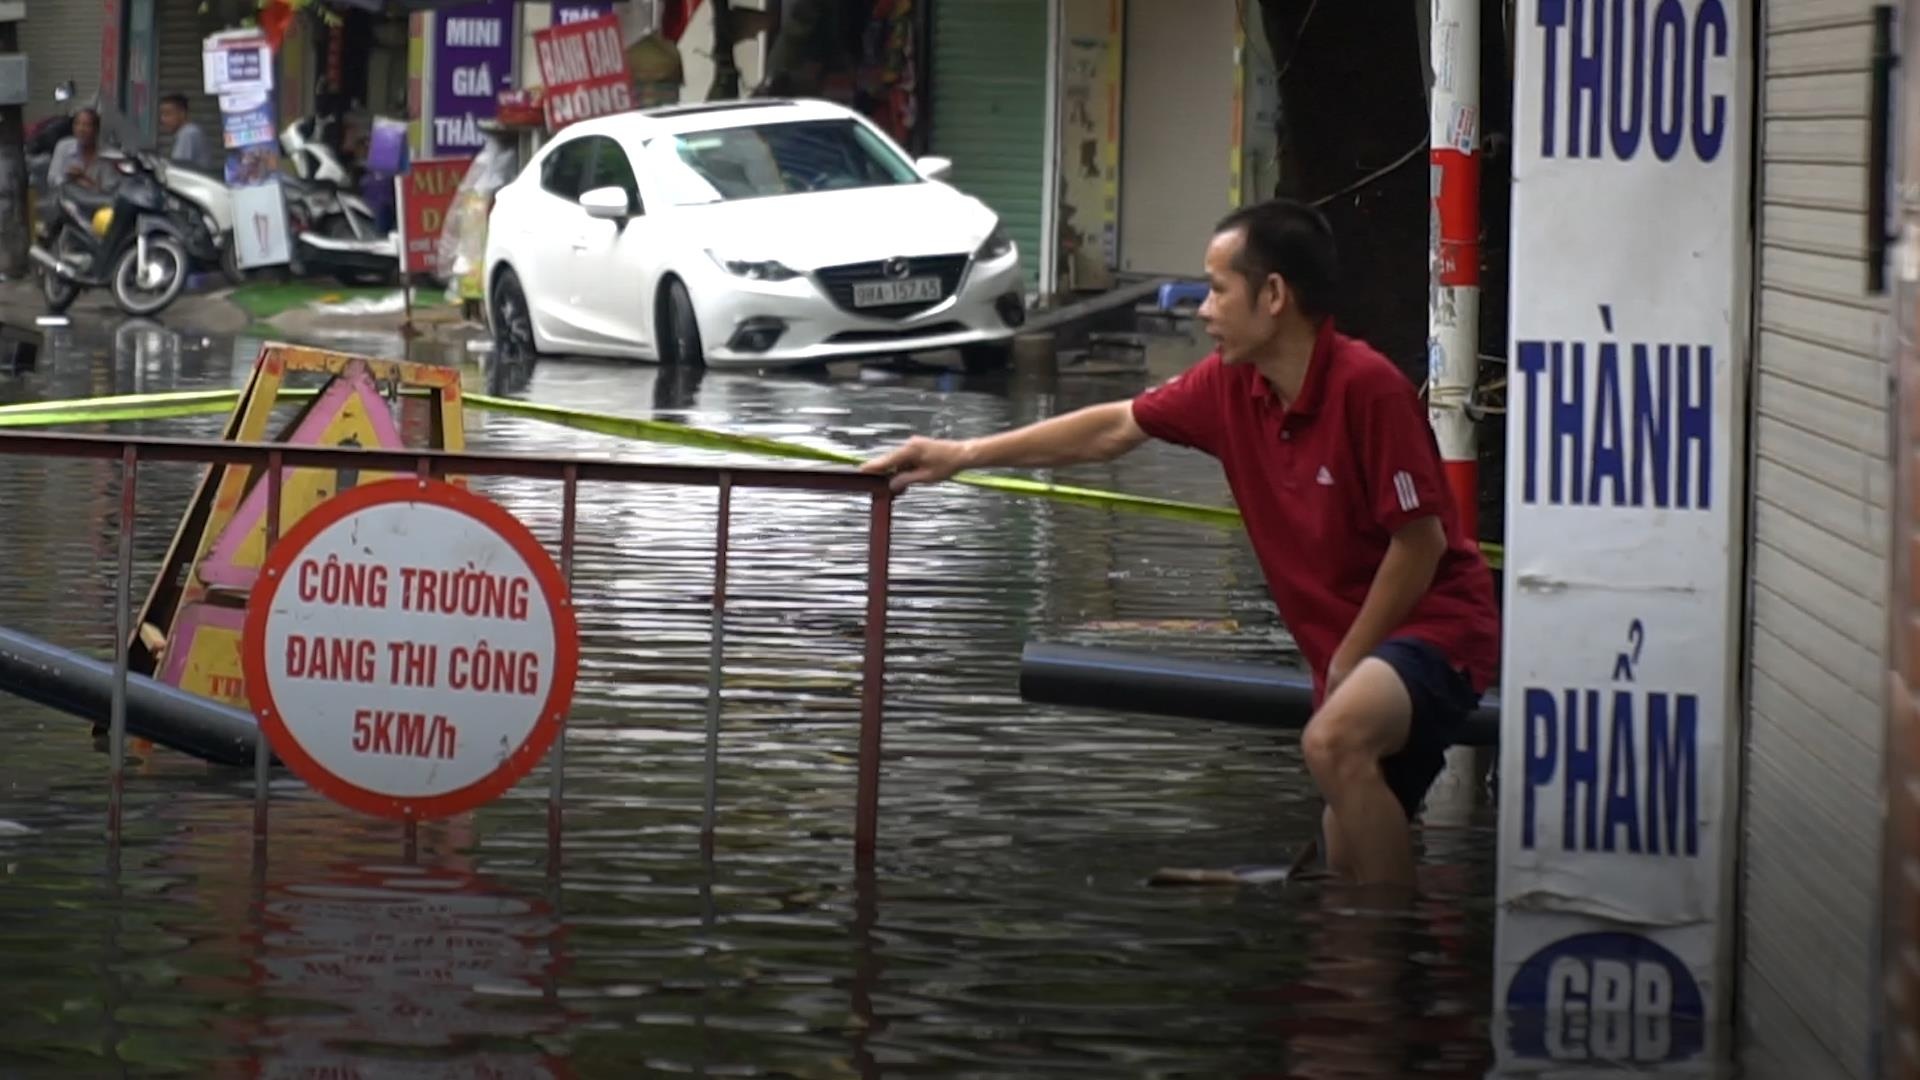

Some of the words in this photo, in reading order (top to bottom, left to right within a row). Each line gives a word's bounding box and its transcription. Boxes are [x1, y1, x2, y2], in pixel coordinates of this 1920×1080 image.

[445, 17, 501, 46] MINI
[586, 28, 623, 79] BAO
[452, 62, 491, 96] GIÁ
[1517, 305, 1712, 510] THÀNH
[299, 554, 388, 609] CÔNG
[400, 561, 528, 621] TRƯỜNG
[286, 635, 376, 683] ĐANG
[387, 641, 438, 688] THI
[448, 640, 539, 695] CÔNG
[352, 710, 456, 760] 5KM/h
[1521, 617, 1699, 857] PHẨM
